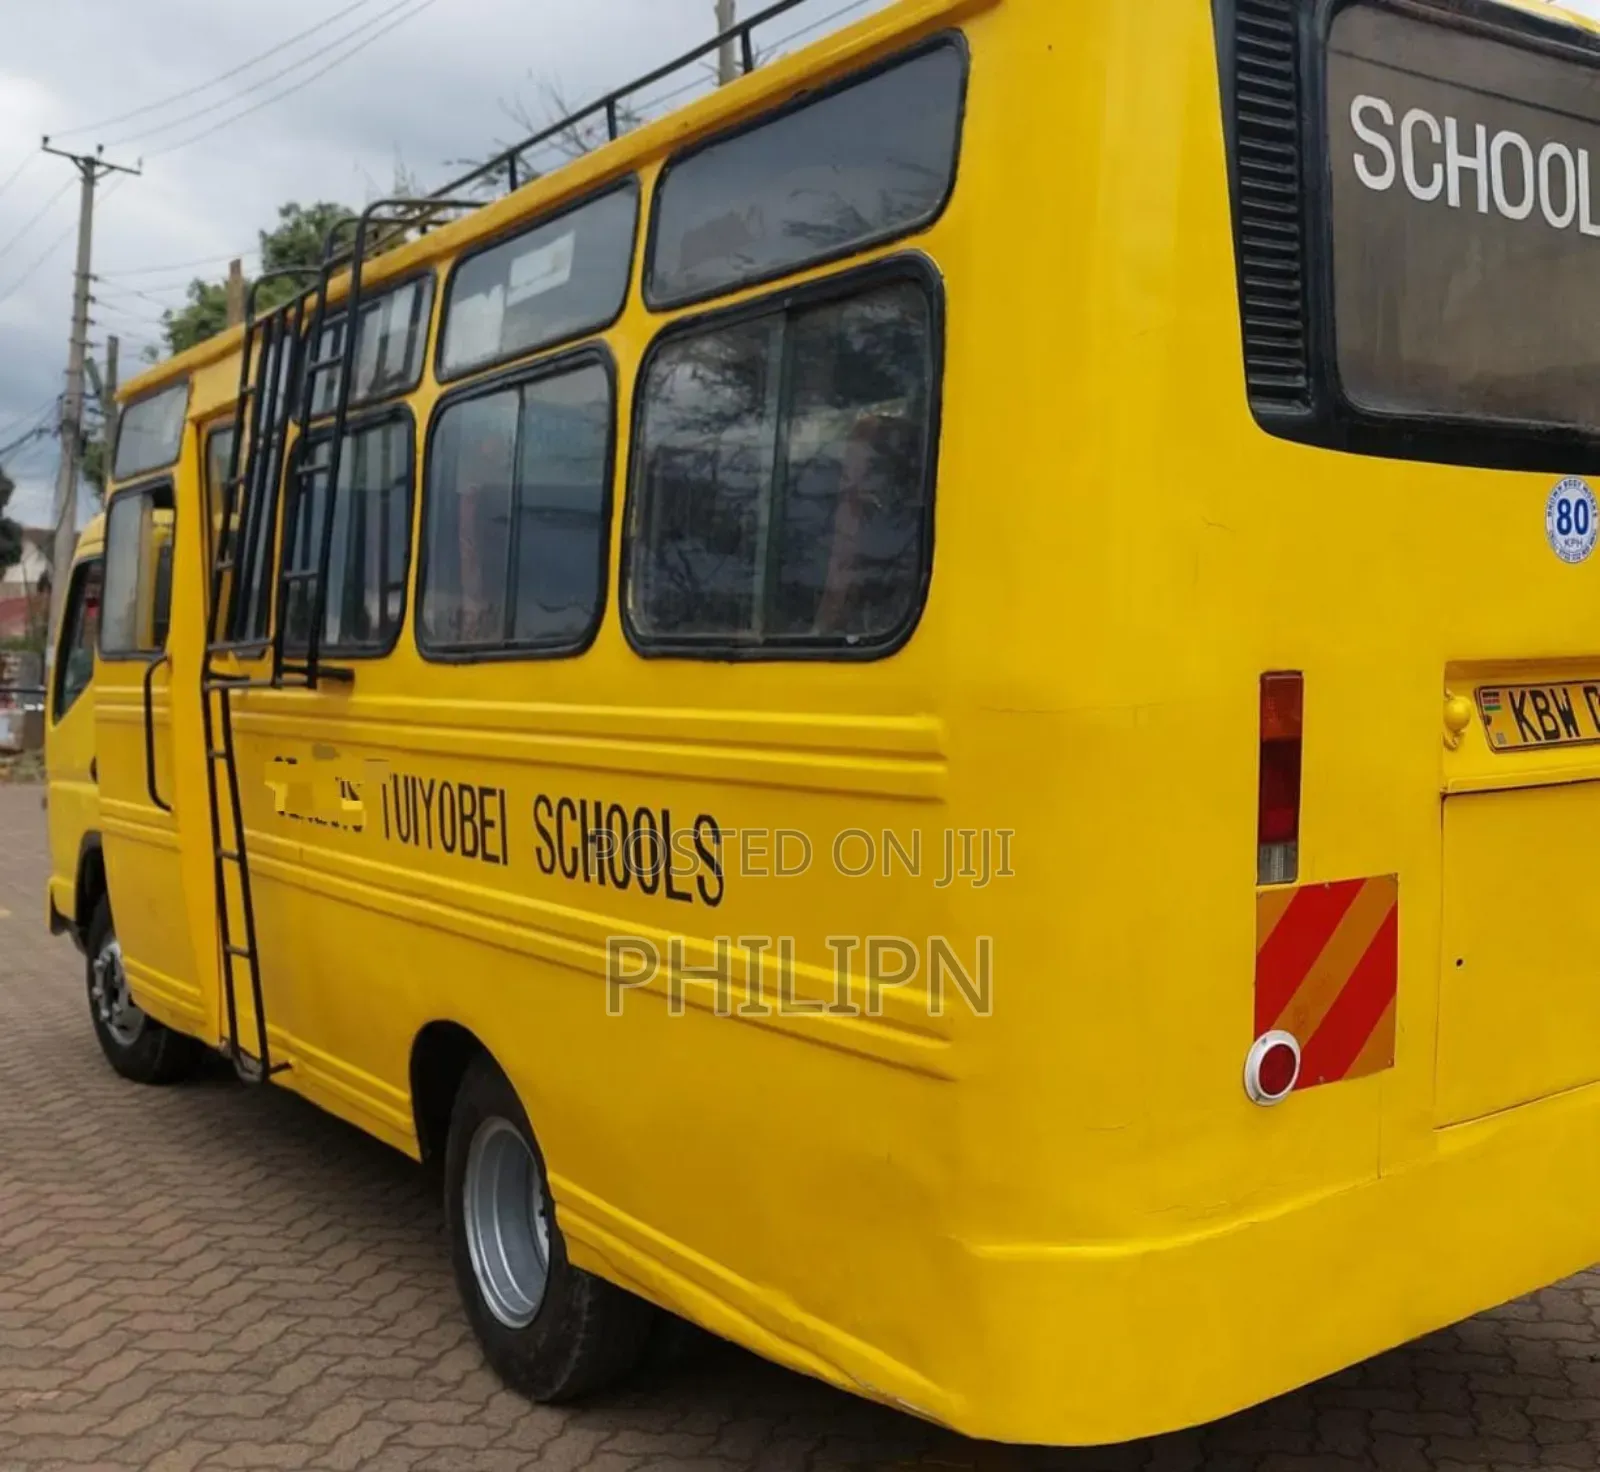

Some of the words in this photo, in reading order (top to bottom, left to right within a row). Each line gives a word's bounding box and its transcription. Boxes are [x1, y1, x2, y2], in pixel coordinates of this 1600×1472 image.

[1350, 94, 1600, 237] SCHOOL
[1556, 498, 1589, 536] 80
[1508, 685, 1581, 742] KBW
[533, 793, 725, 908] SCHOOLS
